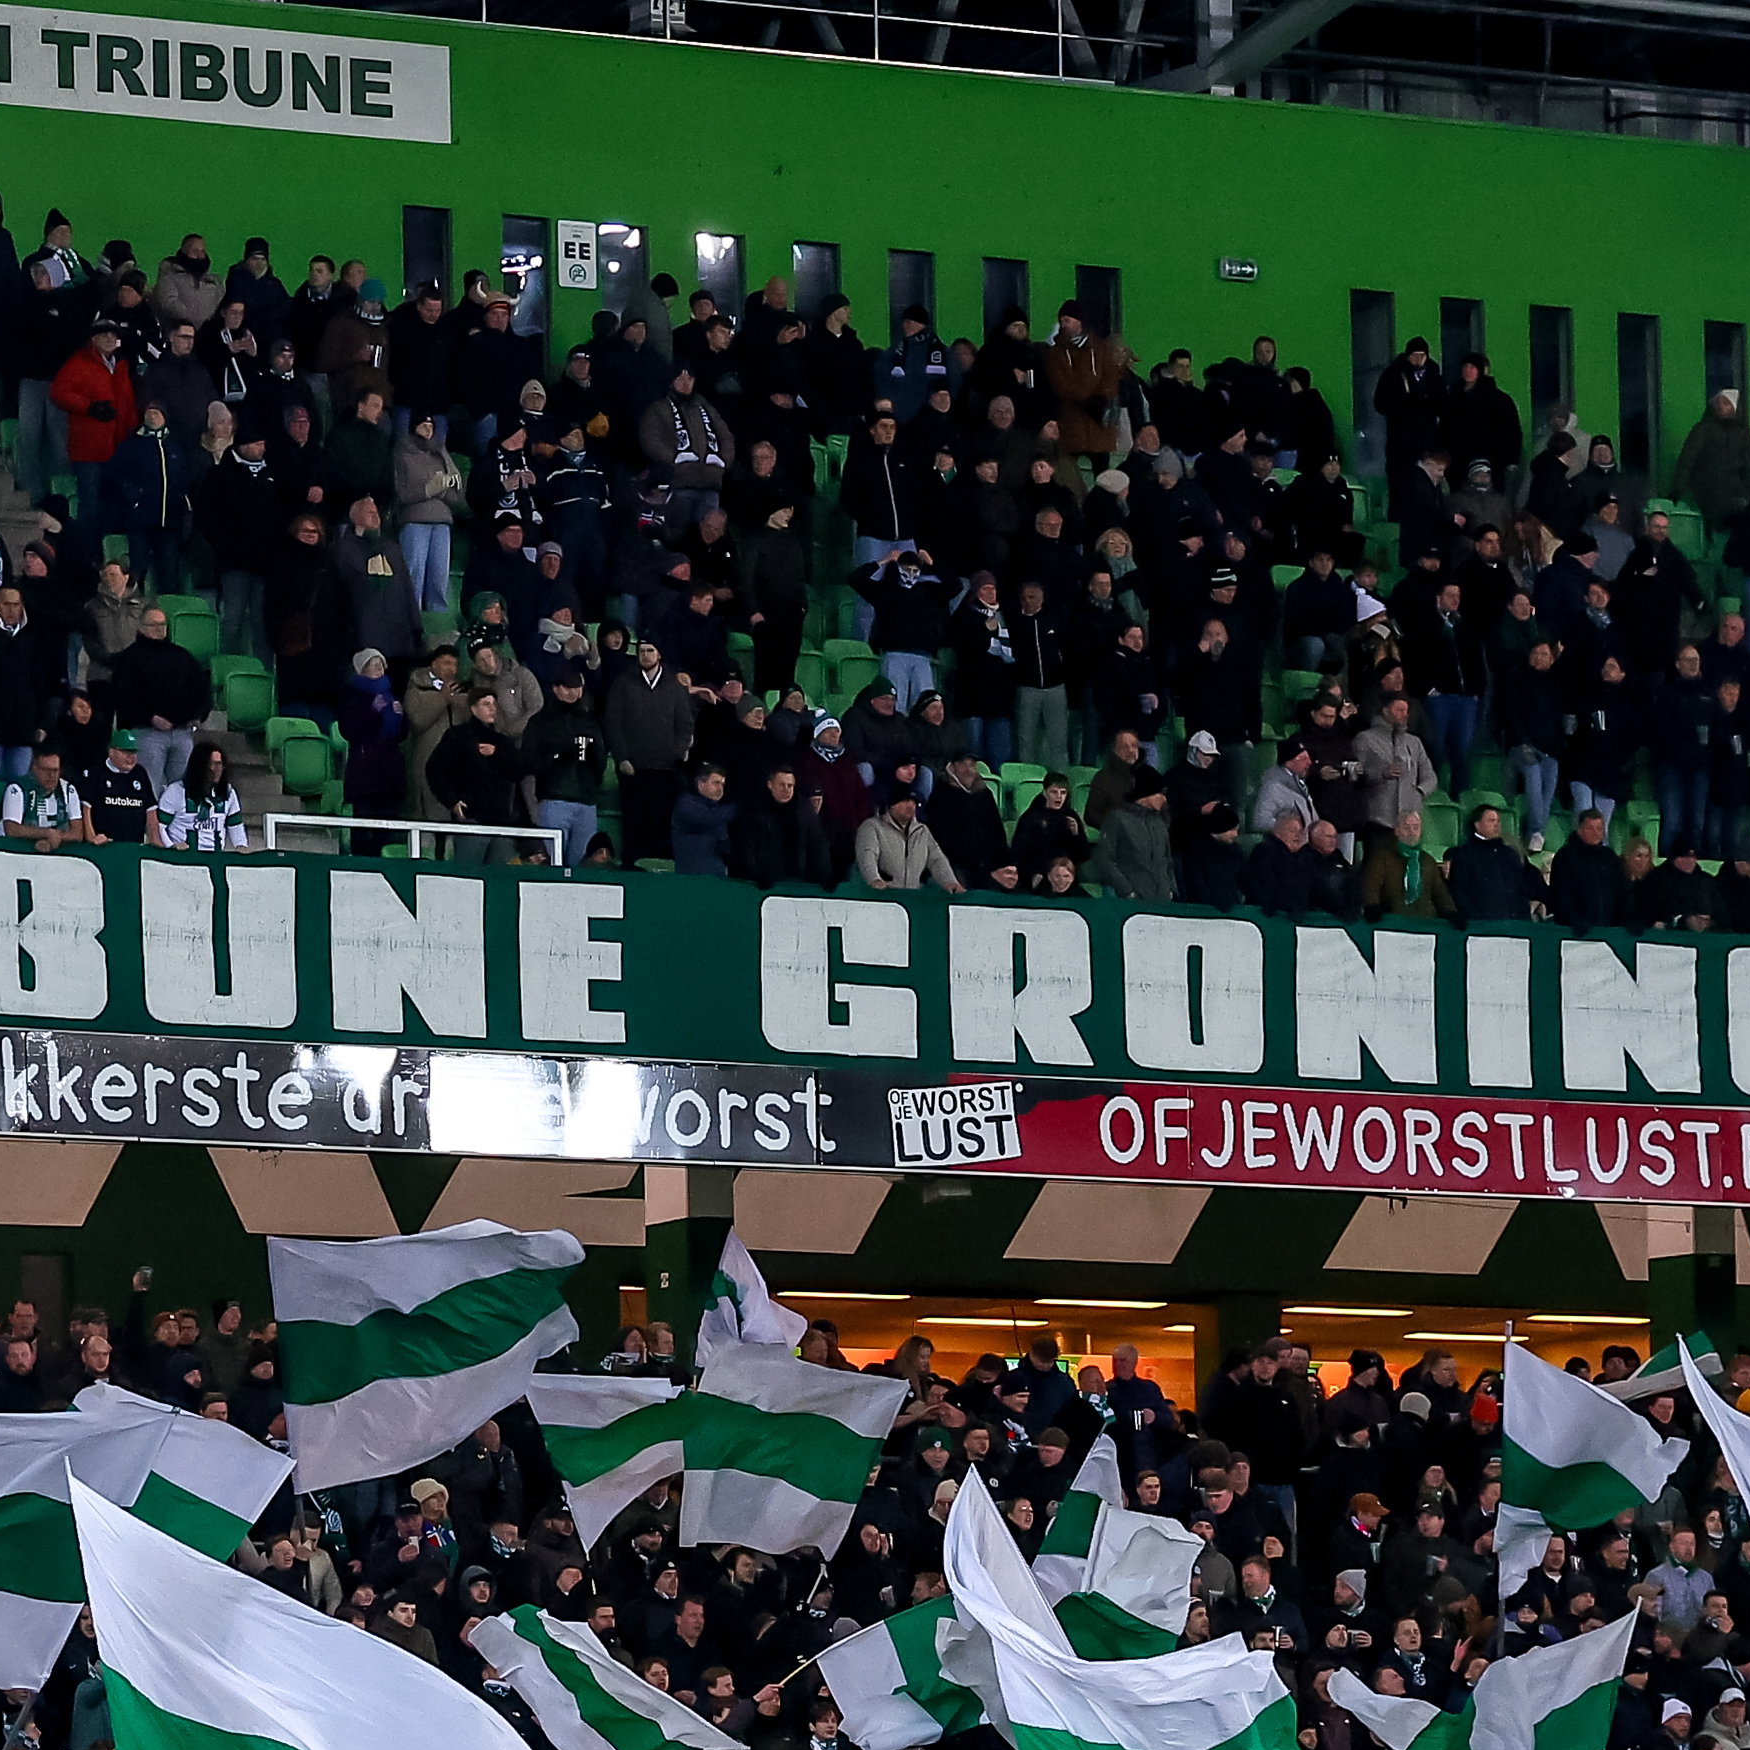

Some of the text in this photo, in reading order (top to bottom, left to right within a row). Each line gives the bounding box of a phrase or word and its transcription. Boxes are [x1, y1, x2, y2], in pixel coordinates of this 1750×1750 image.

[41, 28, 394, 118] TRIBUNE
[564, 241, 591, 260] EE
[889, 1085, 1011, 1118] OF WORST
[894, 1105, 913, 1121] JE
[895, 1114, 1013, 1162] LUST
